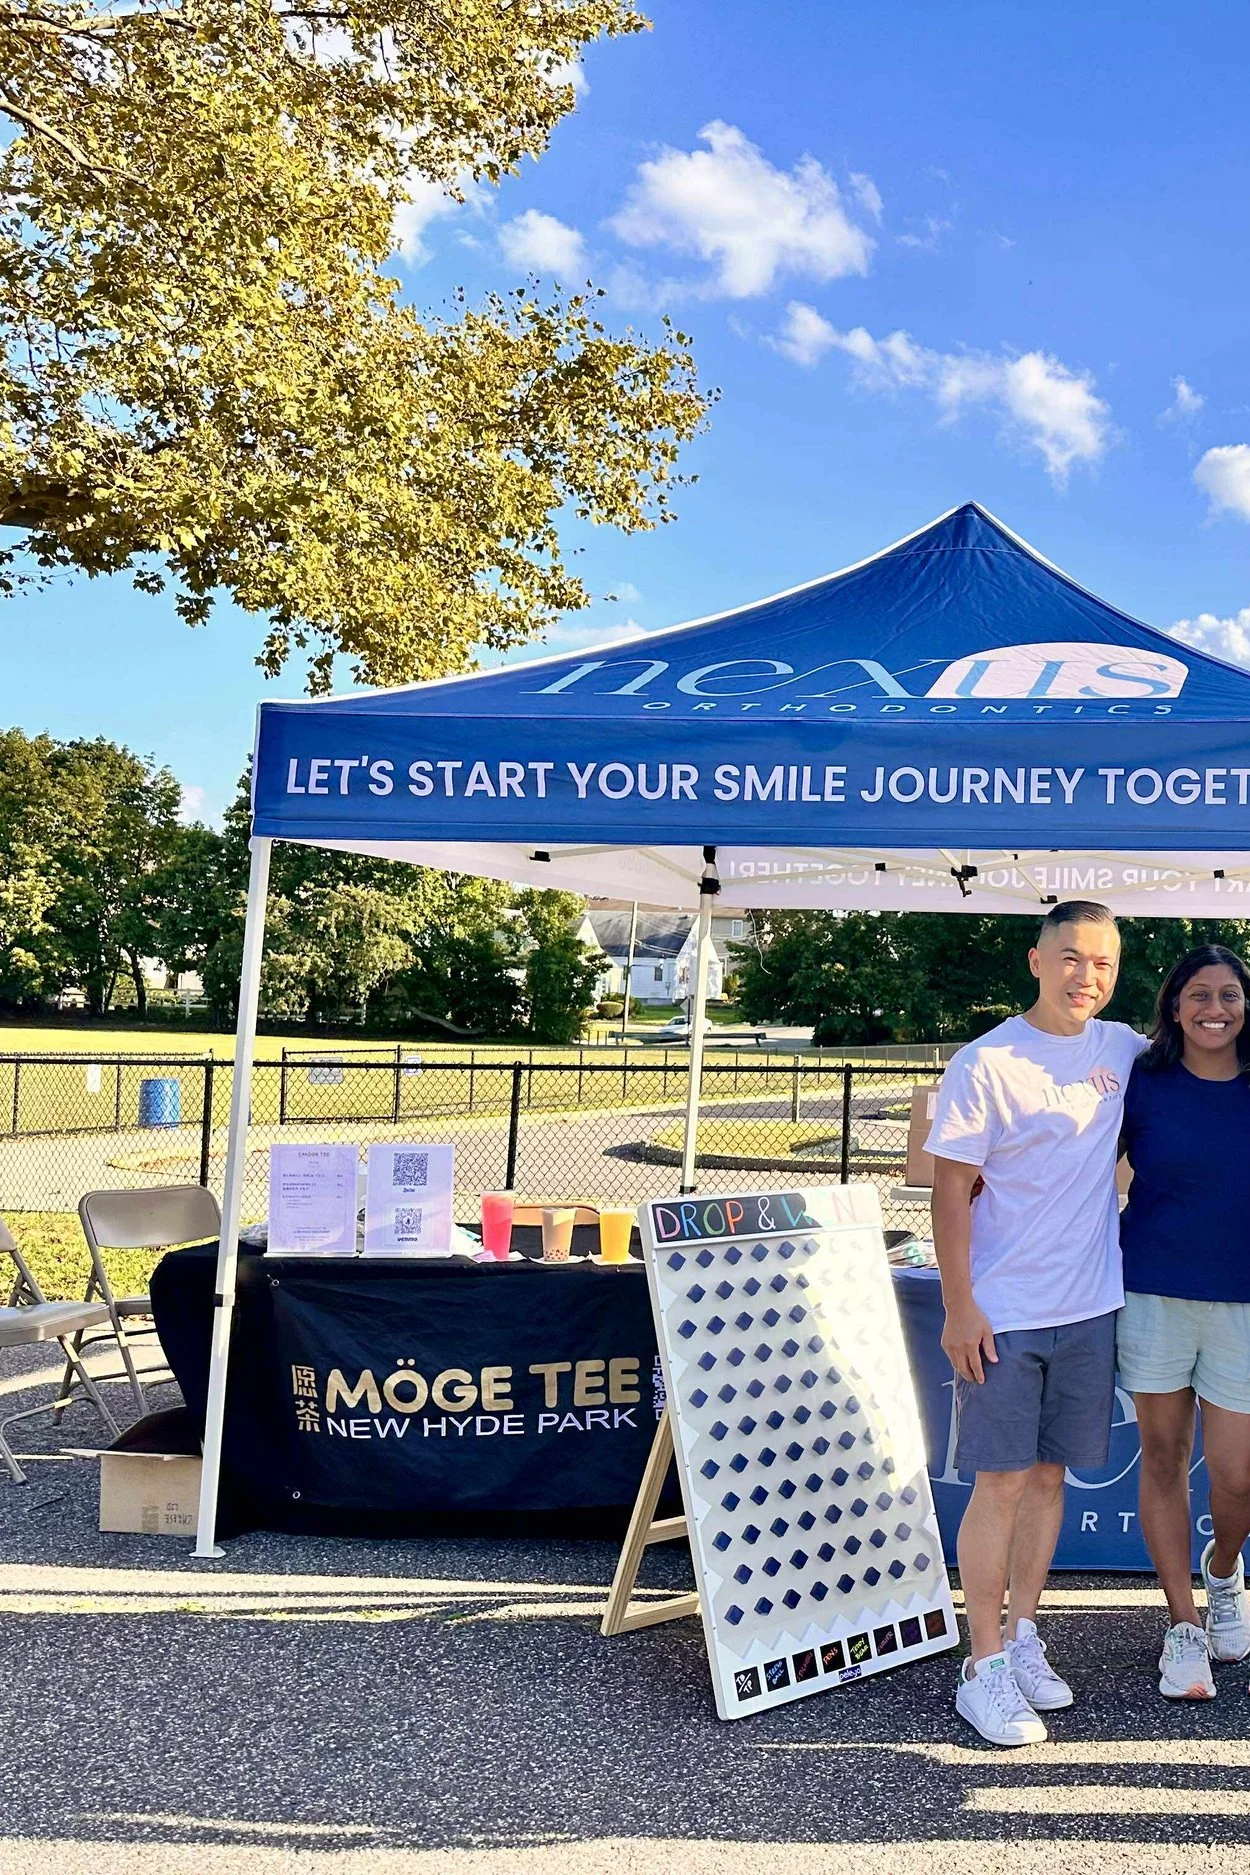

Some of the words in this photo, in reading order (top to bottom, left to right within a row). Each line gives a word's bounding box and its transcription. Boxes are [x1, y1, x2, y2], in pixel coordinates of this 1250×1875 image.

[519, 657, 1188, 699] nexus
[641, 701, 1175, 715] ORTHODONTICS
[286, 755, 394, 796] LET'S
[408, 760, 554, 798] START
[566, 762, 698, 800] YOUR
[714, 764, 846, 802] SMILE
[861, 765, 1083, 804] JOURNEY
[655, 1199, 744, 1239] DROP
[758, 1196, 776, 1231] &
[325, 1358, 514, 1414] MÖGE
[529, 1357, 641, 1408] TEE
[327, 1416, 410, 1439] NEW
[423, 1414, 525, 1437] HYDE
[538, 1407, 638, 1434] PARK
